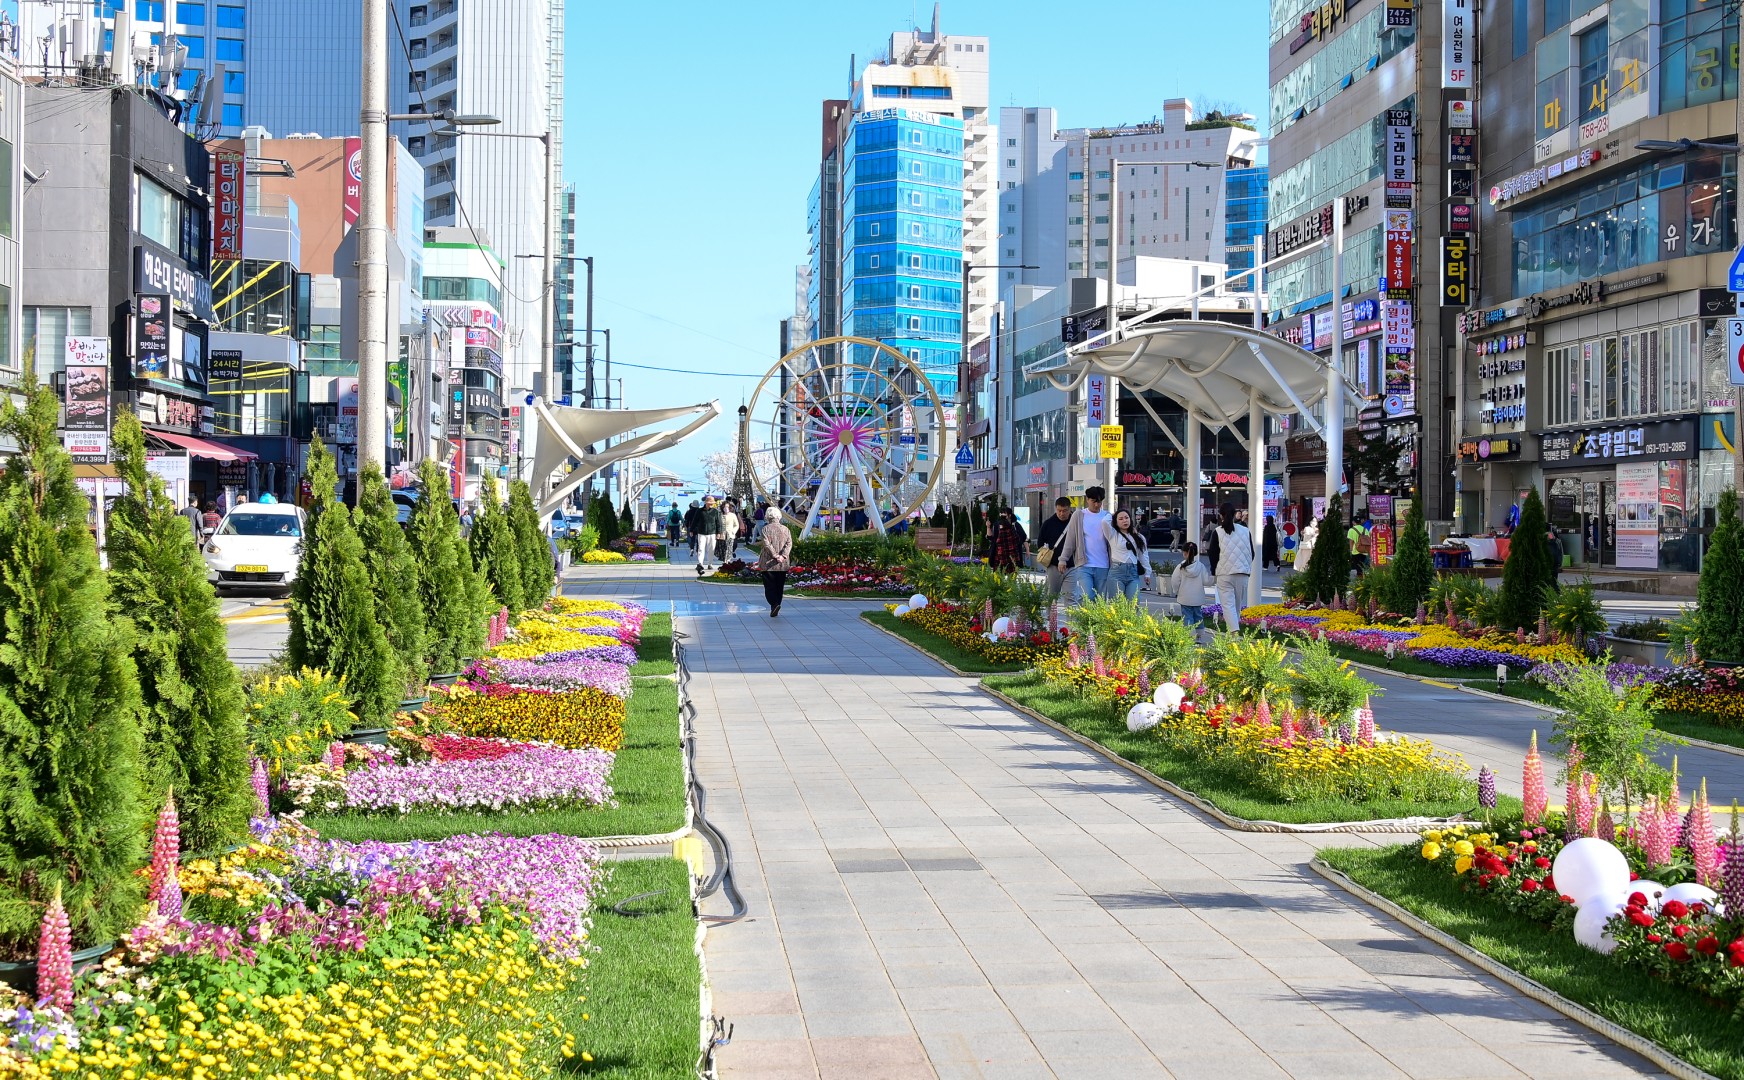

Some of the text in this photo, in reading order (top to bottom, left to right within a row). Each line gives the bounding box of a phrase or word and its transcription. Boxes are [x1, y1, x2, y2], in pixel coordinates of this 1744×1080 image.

[1453, 16, 1463, 63] 여성전용
[1451, 69, 1465, 81] 5F
[1391, 110, 1409, 118] TOP
[1394, 127, 1405, 179] 노래타운
[1537, 140, 1552, 159] Thai
[220, 162, 241, 253] 타이마사지
[1388, 232, 1410, 243] 미우
[144, 251, 171, 293] 해운대
[1394, 243, 1403, 288] 숯불갈비
[1447, 239, 1467, 303] 궁타이
[1066, 317, 1074, 340] BAR
[75, 352, 105, 364] 맛있다
[1091, 381, 1102, 420] 낙곱새
[1708, 399, 1728, 407] TAKE
[1584, 428, 1645, 458] 초량밀면
